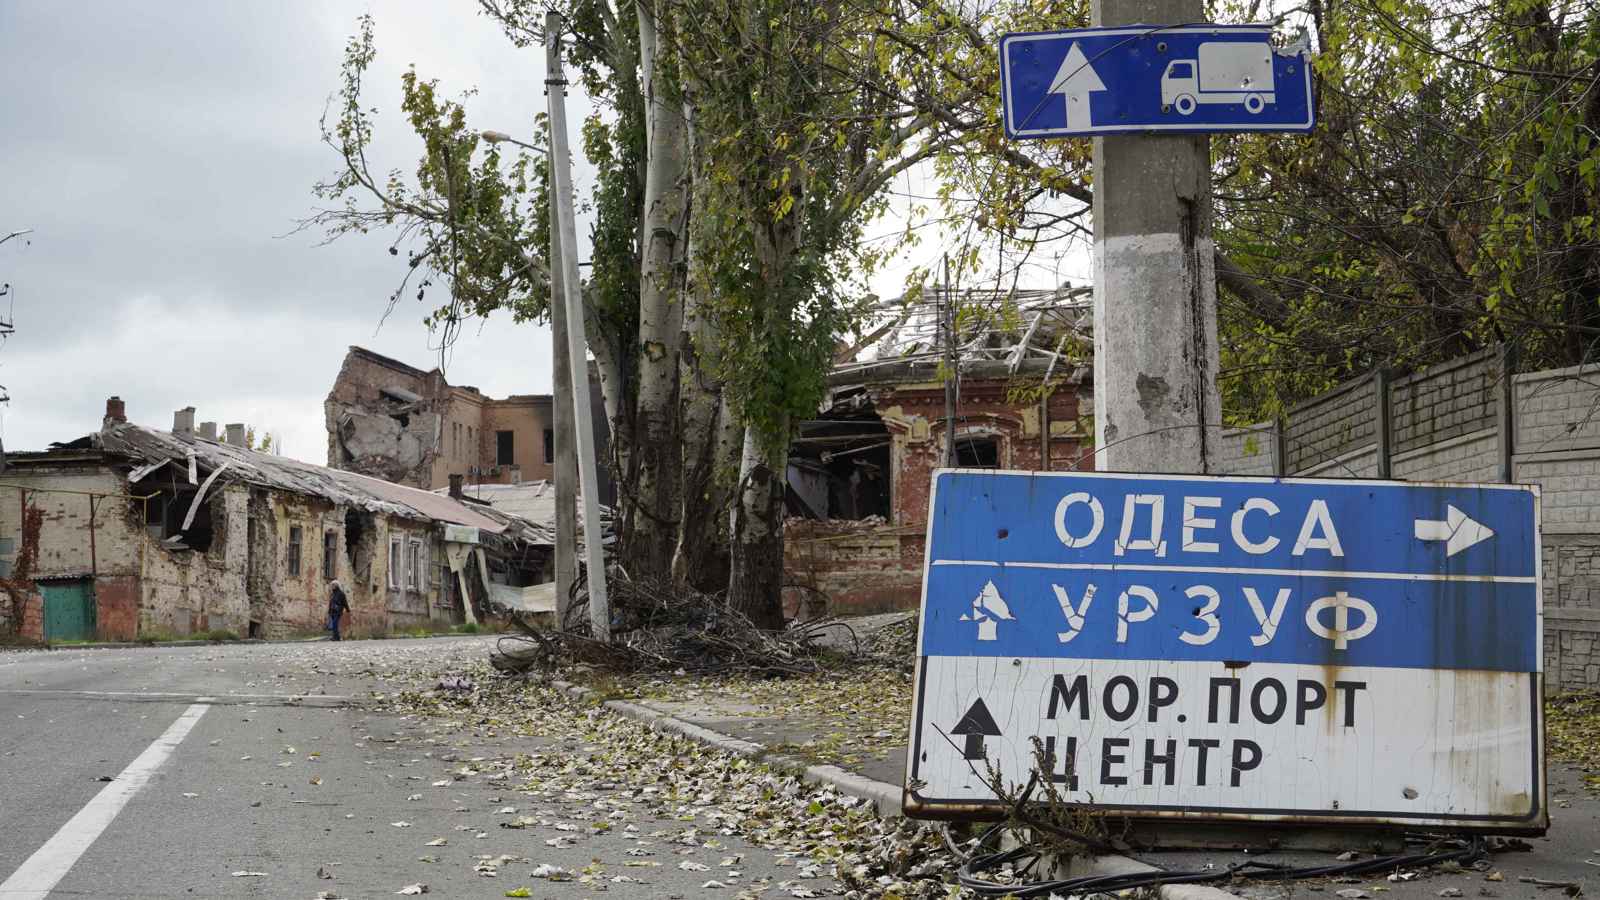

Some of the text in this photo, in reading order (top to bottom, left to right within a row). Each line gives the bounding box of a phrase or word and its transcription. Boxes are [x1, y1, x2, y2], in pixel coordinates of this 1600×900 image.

[1054, 492, 1344, 557] ОДЕСА
[1053, 583, 1378, 650] УРЗУФ
[1047, 674, 1367, 727] МОР. ПОРТ
[1043, 736, 1263, 791] ЦЕНТР
